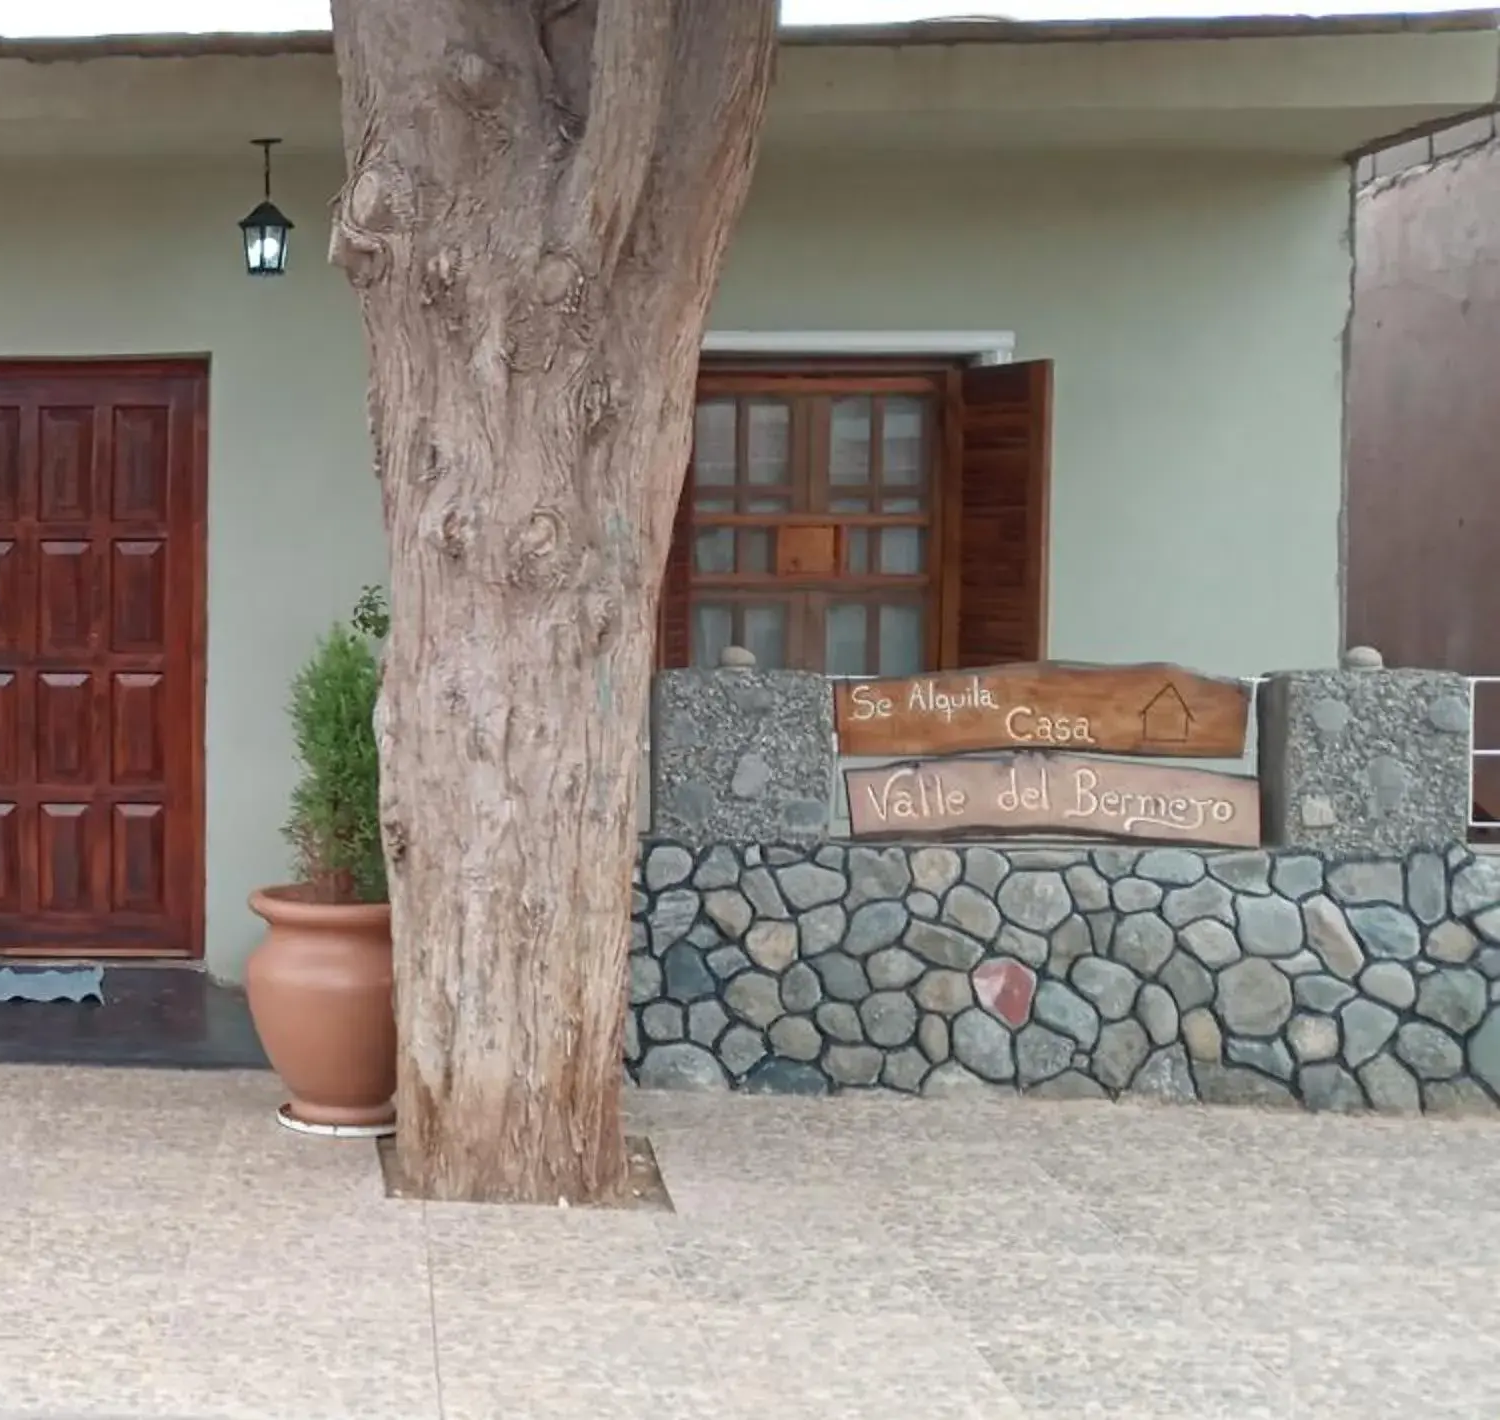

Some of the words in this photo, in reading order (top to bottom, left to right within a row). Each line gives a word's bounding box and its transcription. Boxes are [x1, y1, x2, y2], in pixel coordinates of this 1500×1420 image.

[848, 685, 893, 721] Se
[907, 676, 999, 722] Alquila
[1005, 706, 1095, 744] Casa
[867, 768, 966, 821] Valle
[997, 767, 1049, 813] del
[1063, 768, 1234, 831] Bermejo
